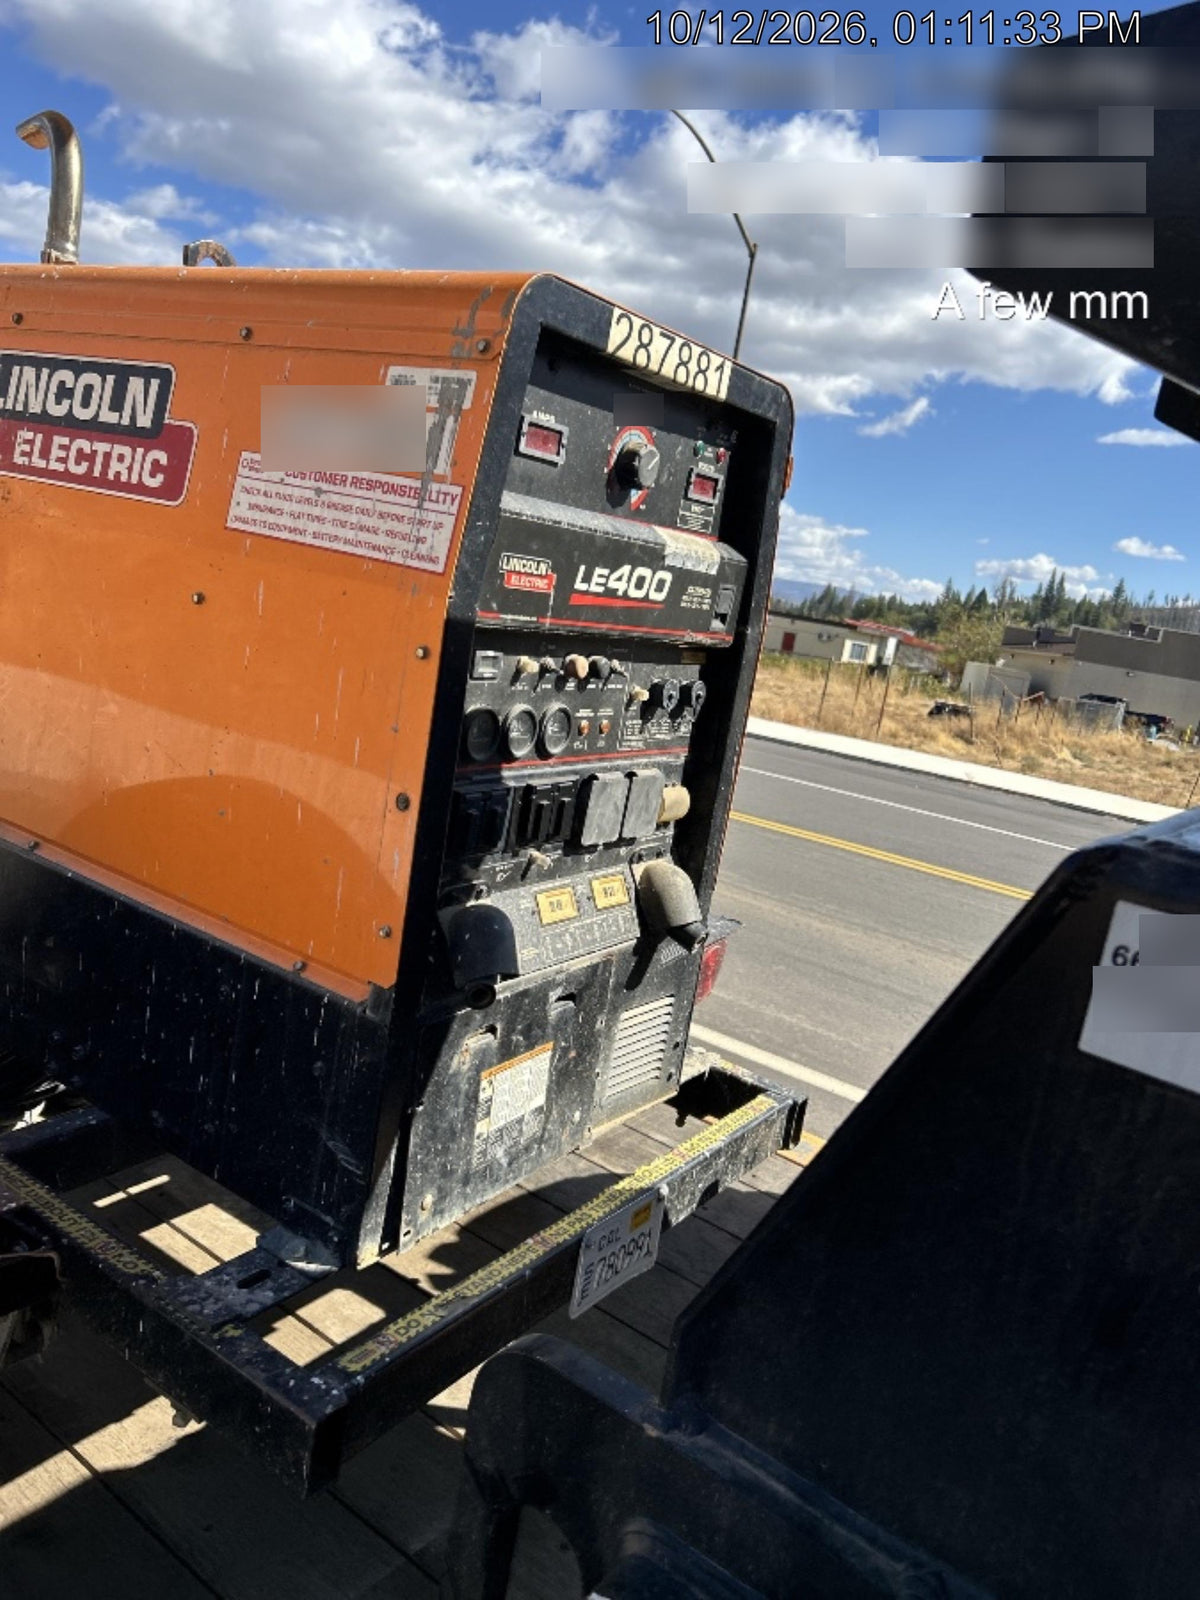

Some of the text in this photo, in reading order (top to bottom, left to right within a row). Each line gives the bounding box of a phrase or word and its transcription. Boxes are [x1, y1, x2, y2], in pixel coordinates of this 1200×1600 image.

[610, 311, 727, 401] 287881
[0, 364, 161, 429] INCOLN
[13, 430, 168, 488] ELECTRIC
[350, 475, 459, 507] RESPONSIBLITY
[502, 555, 548, 576] LINCOLN
[510, 576, 549, 591] ELECTRIC
[573, 564, 672, 601] LE400
